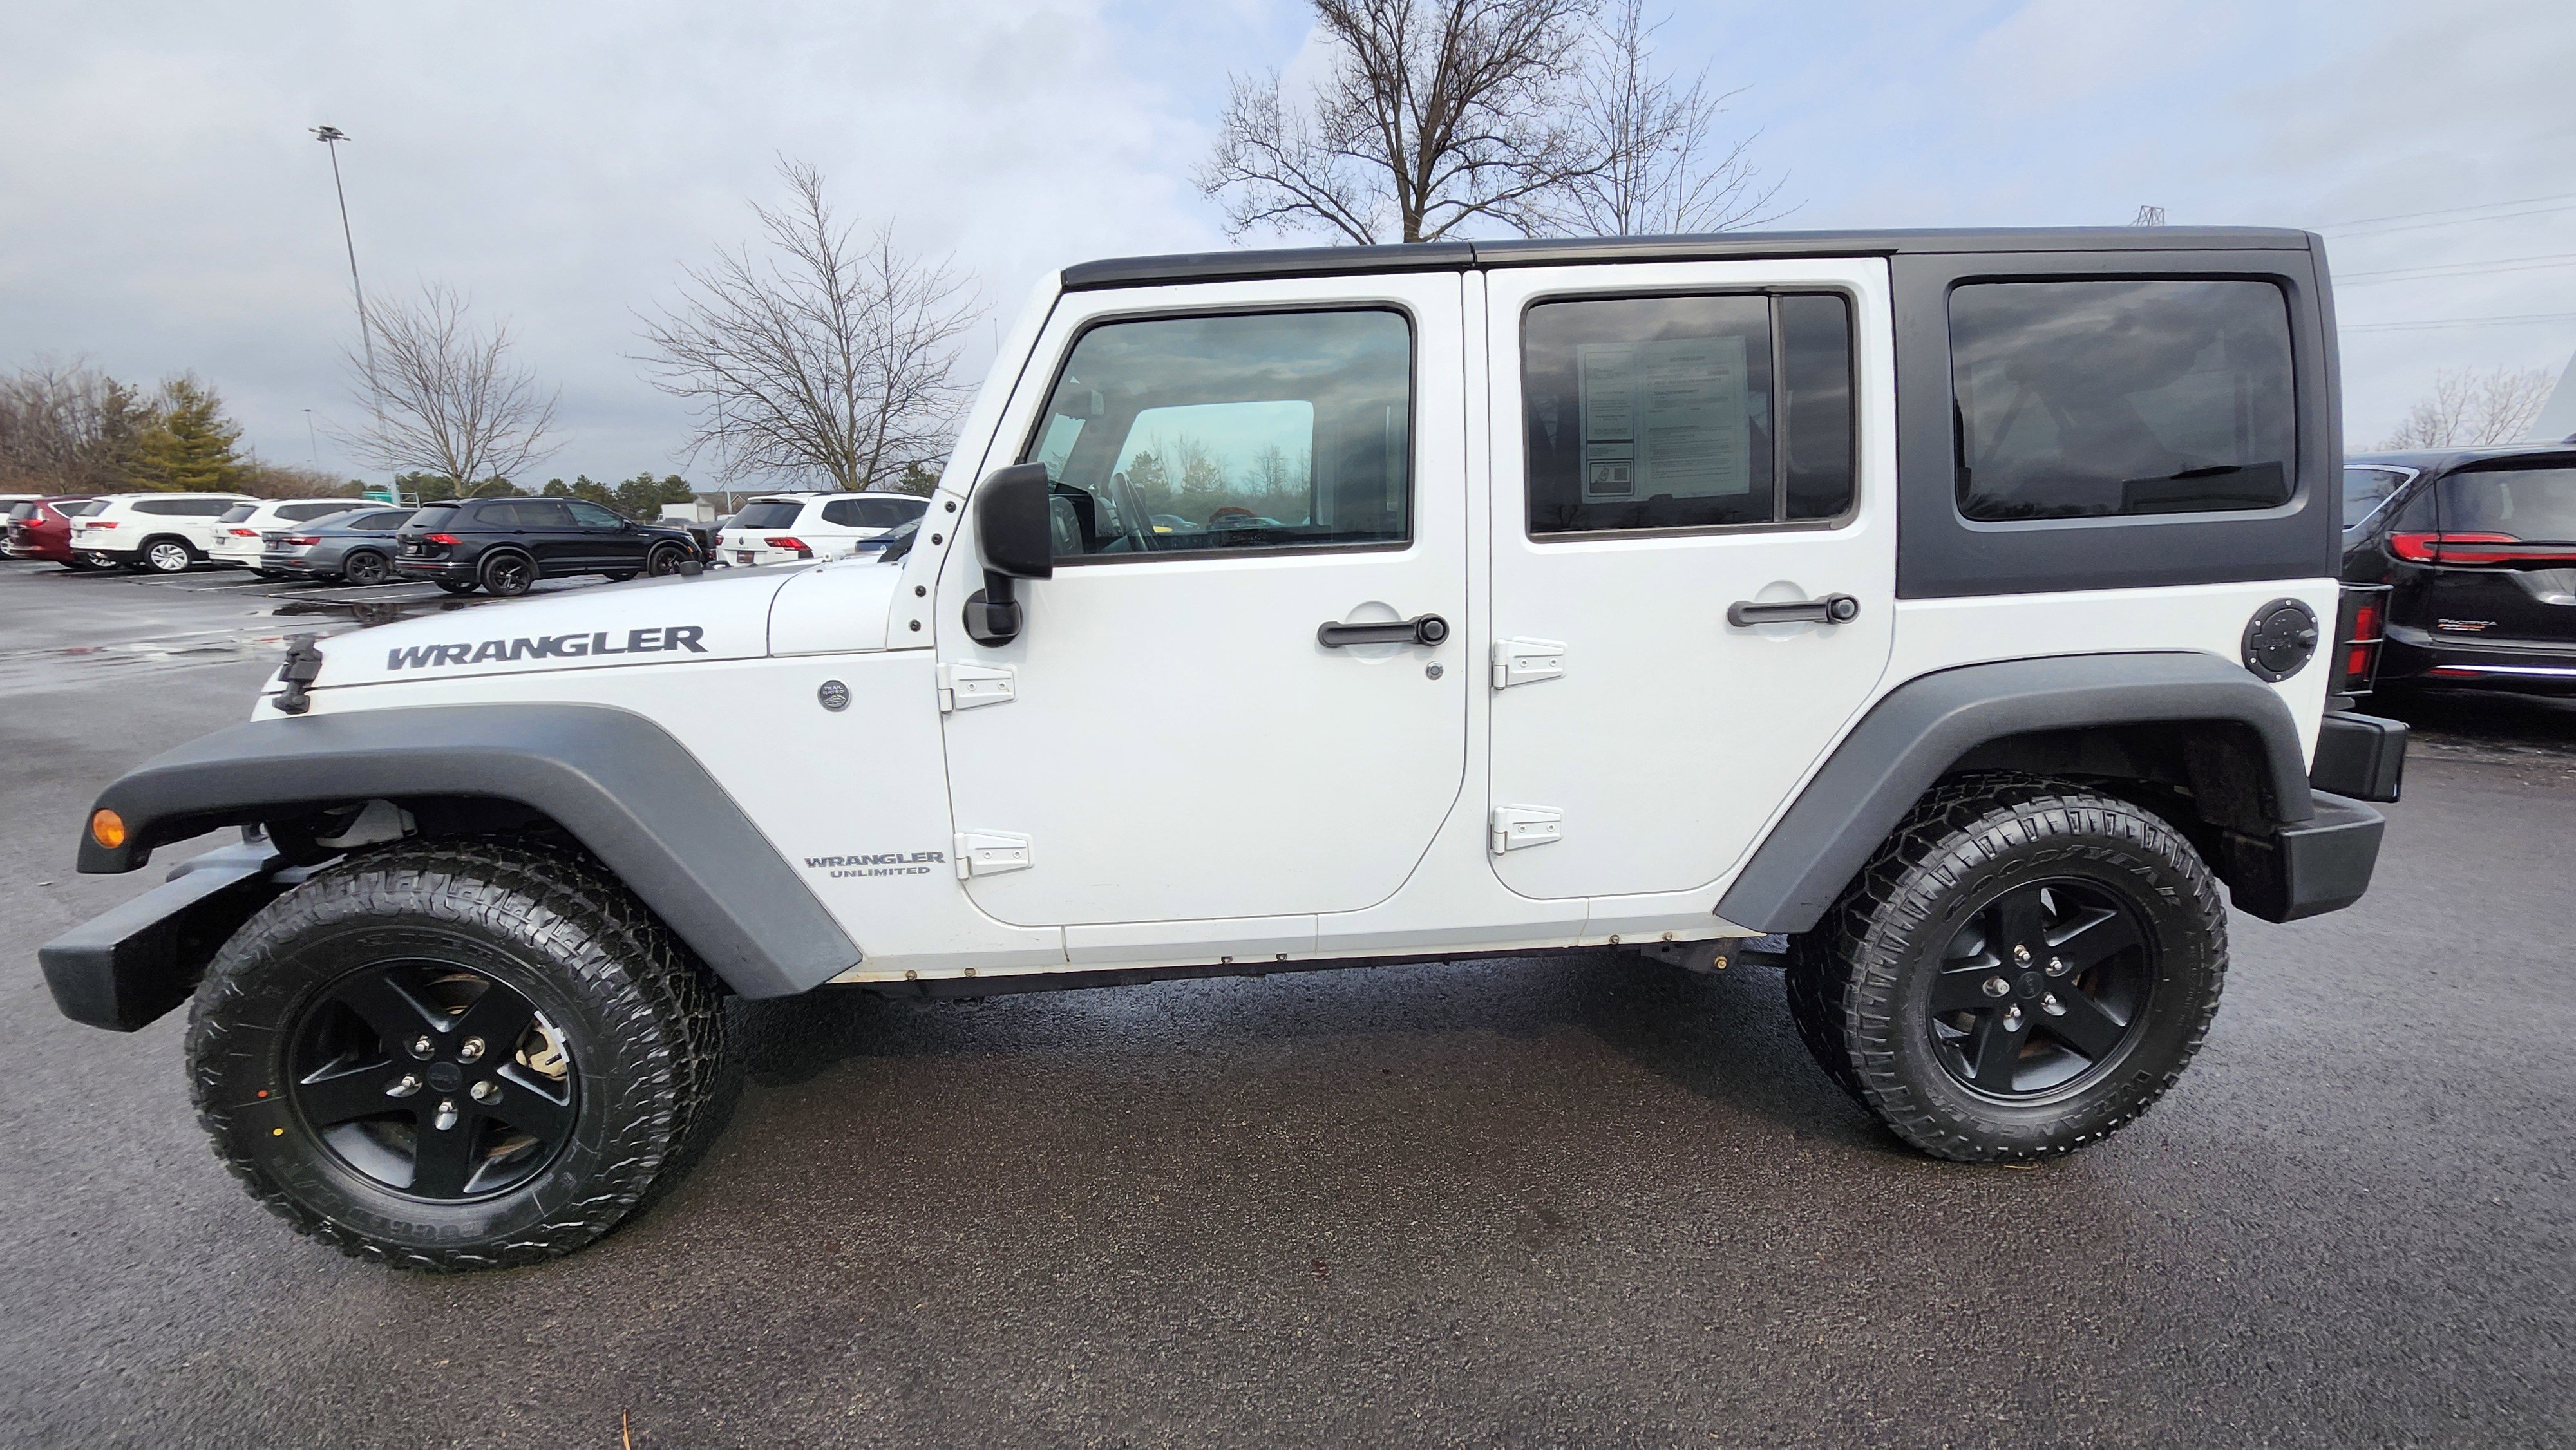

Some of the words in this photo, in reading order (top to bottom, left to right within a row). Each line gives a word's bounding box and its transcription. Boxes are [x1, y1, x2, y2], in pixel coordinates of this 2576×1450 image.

[386, 625, 709, 671] WRANGLER
[804, 851, 946, 869] WRANGLER
[830, 867, 931, 878] UNLIMITED
